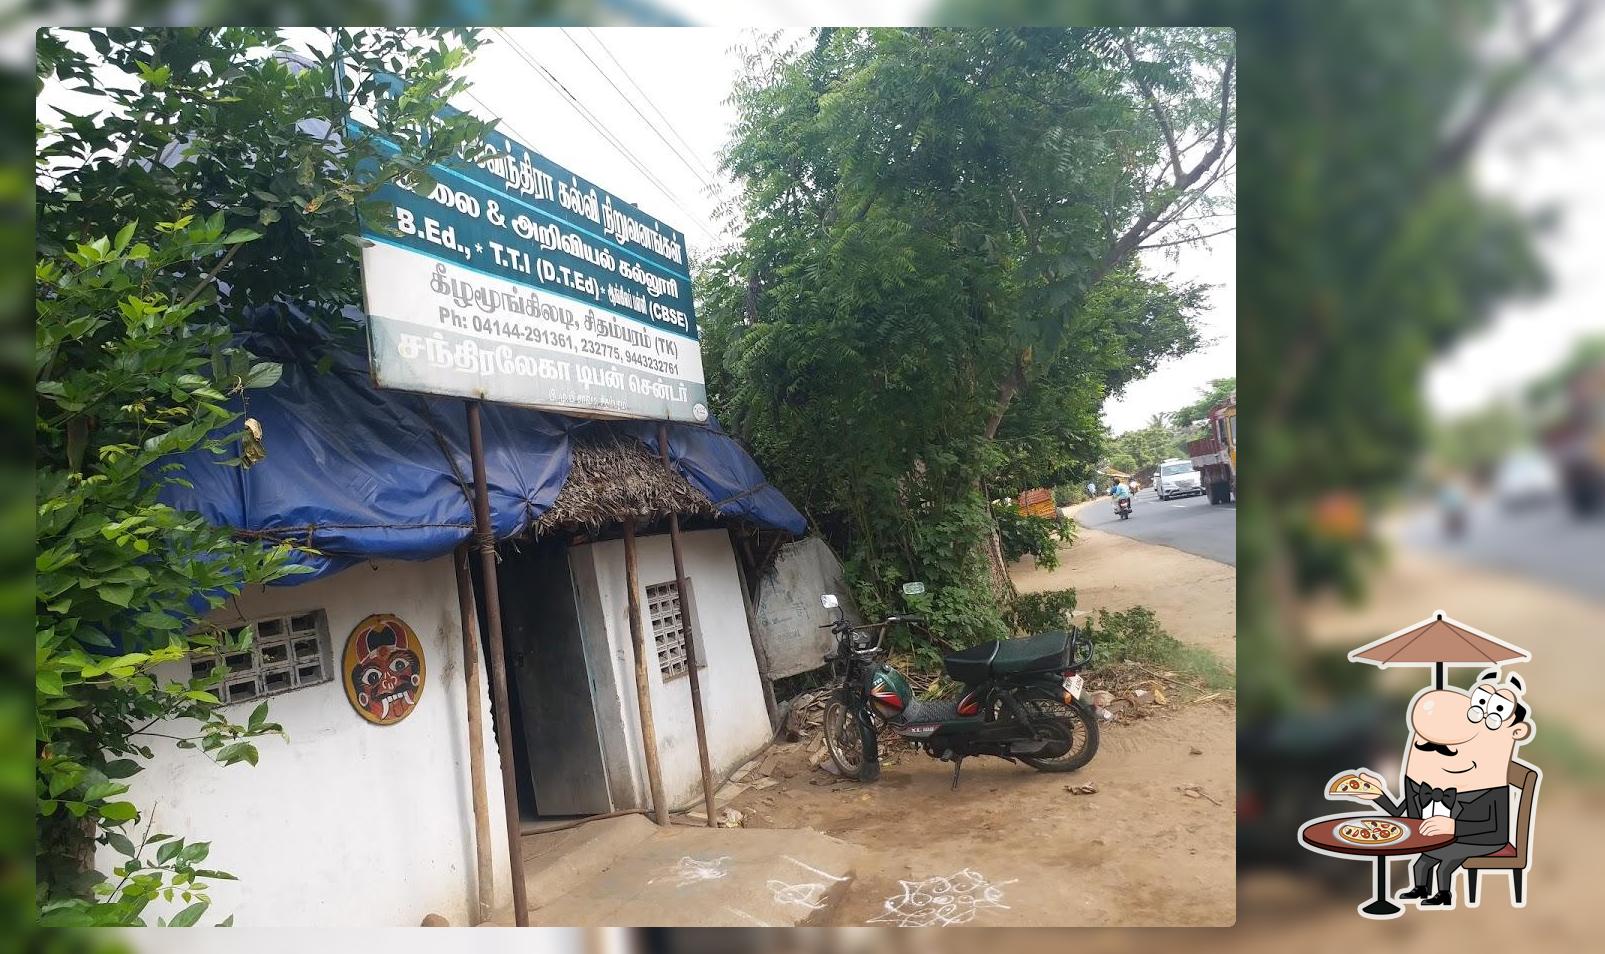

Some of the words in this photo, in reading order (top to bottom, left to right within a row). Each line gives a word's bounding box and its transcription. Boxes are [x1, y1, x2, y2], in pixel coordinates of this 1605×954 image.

[396, 174, 481, 218] லை
[486, 199, 508, 228] &
[511, 214, 616, 272] அறிவியல்
[618, 259, 679, 299] கல்லூரி
[558, 176, 601, 224] கல்வி
[601, 195, 683, 265] நிறுவனங்கள்
[536, 257, 600, 301] (D.T.Ed)
[649, 300, 689, 332] (CBSE)
[439, 306, 468, 329] Ph:
[472, 315, 578, 353] 04144-291361,
[625, 350, 679, 376] 9443232761
[584, 309, 652, 350] சிதம்பரம்
[655, 336, 678, 360] (TK)
[576, 363, 625, 391] டிபன்
[628, 374, 688, 403] சென்டர்
